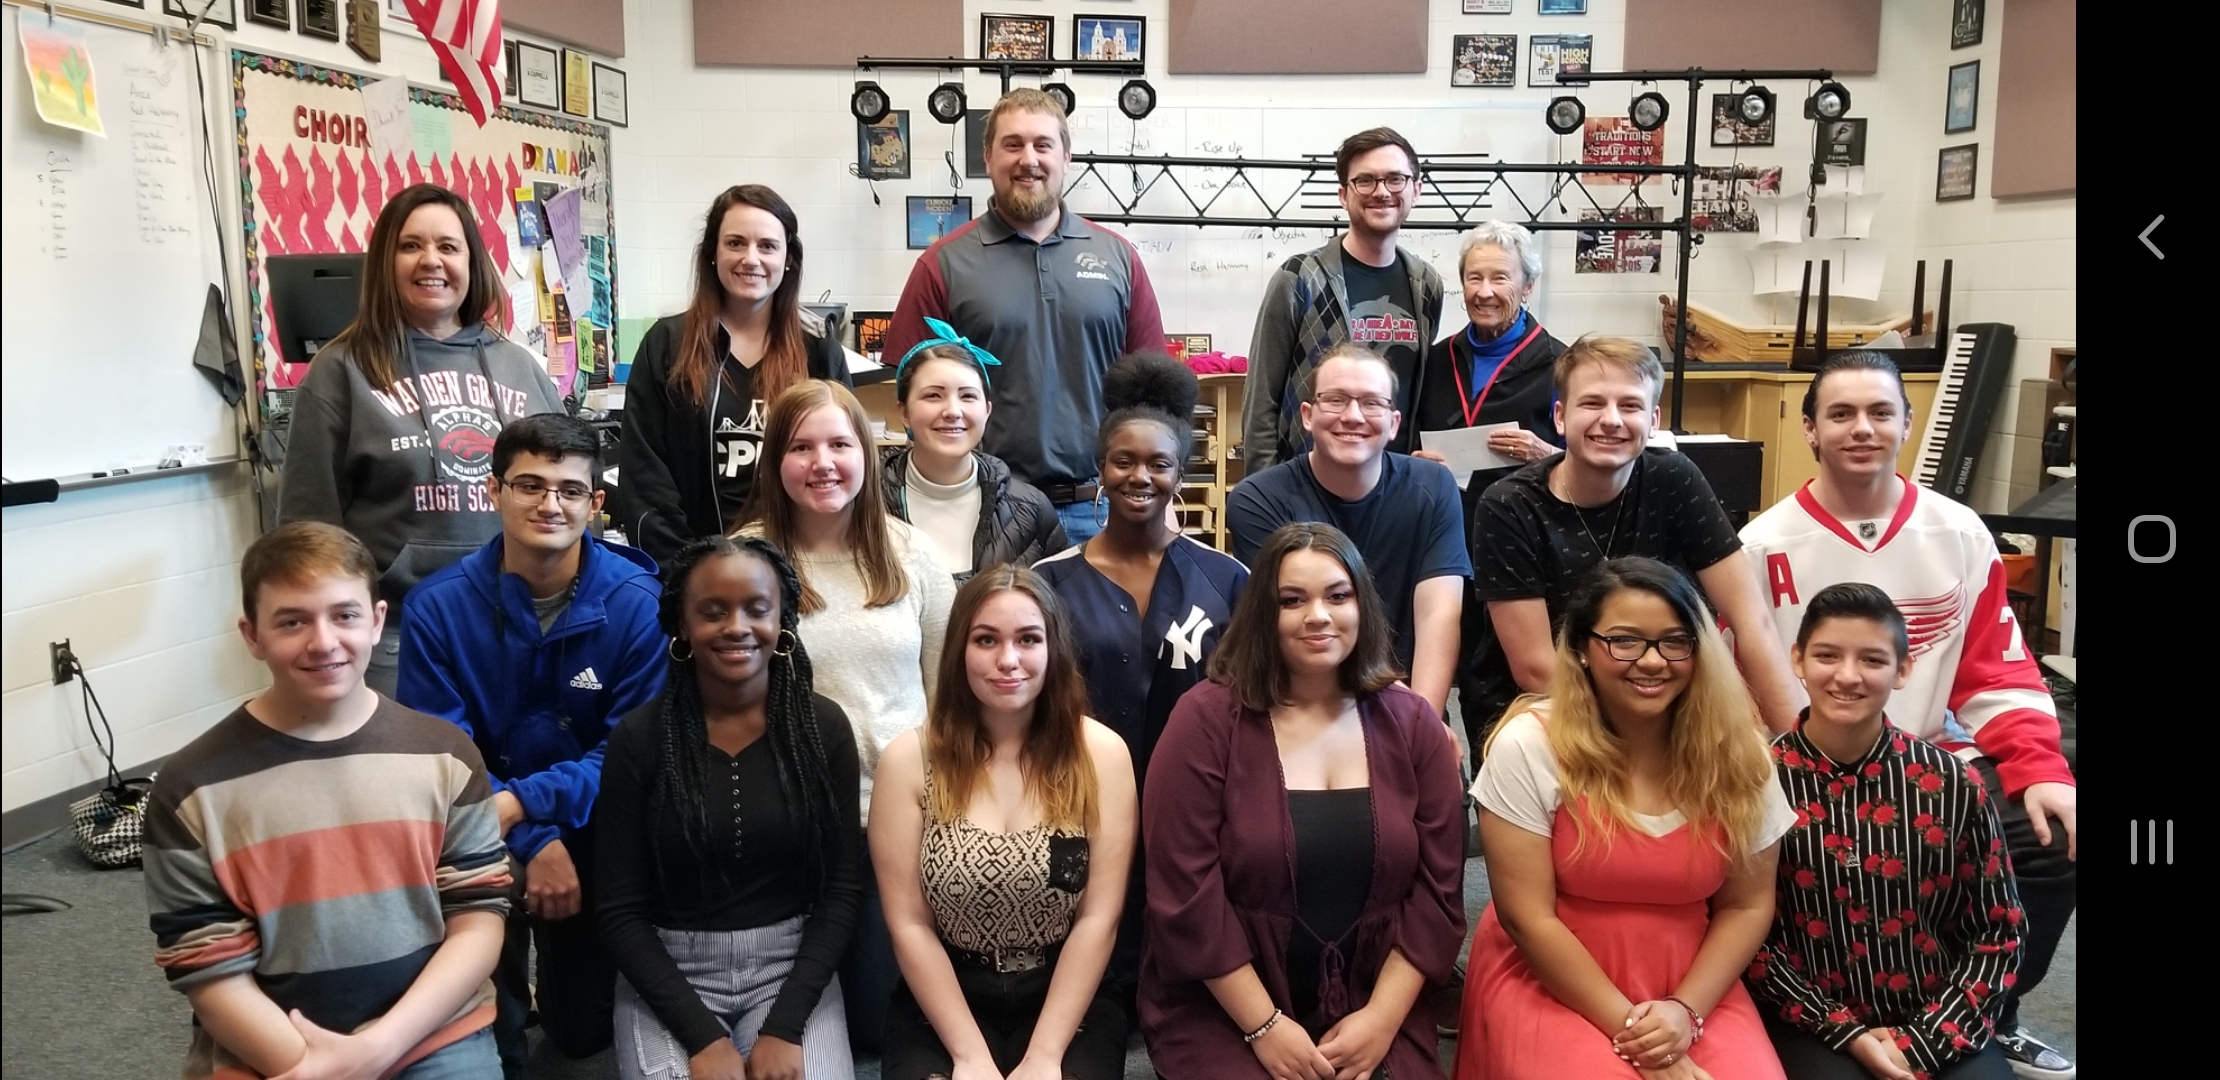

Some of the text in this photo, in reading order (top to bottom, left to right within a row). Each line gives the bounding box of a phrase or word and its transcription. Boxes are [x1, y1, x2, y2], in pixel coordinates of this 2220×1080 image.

[294, 104, 373, 149] CHOIR
[1594, 130, 1652, 143] TRADITIONS
[522, 141, 580, 177] DRAMA
[1592, 145, 1654, 156] START NOW
[436, 412, 493, 432] ALPHAS
[390, 435, 425, 452] EST.
[1957, 456, 1974, 486] YAMAHA
[414, 483, 460, 513] HIGH
[1766, 551, 1800, 609] A
[569, 679, 603, 691] adidas
